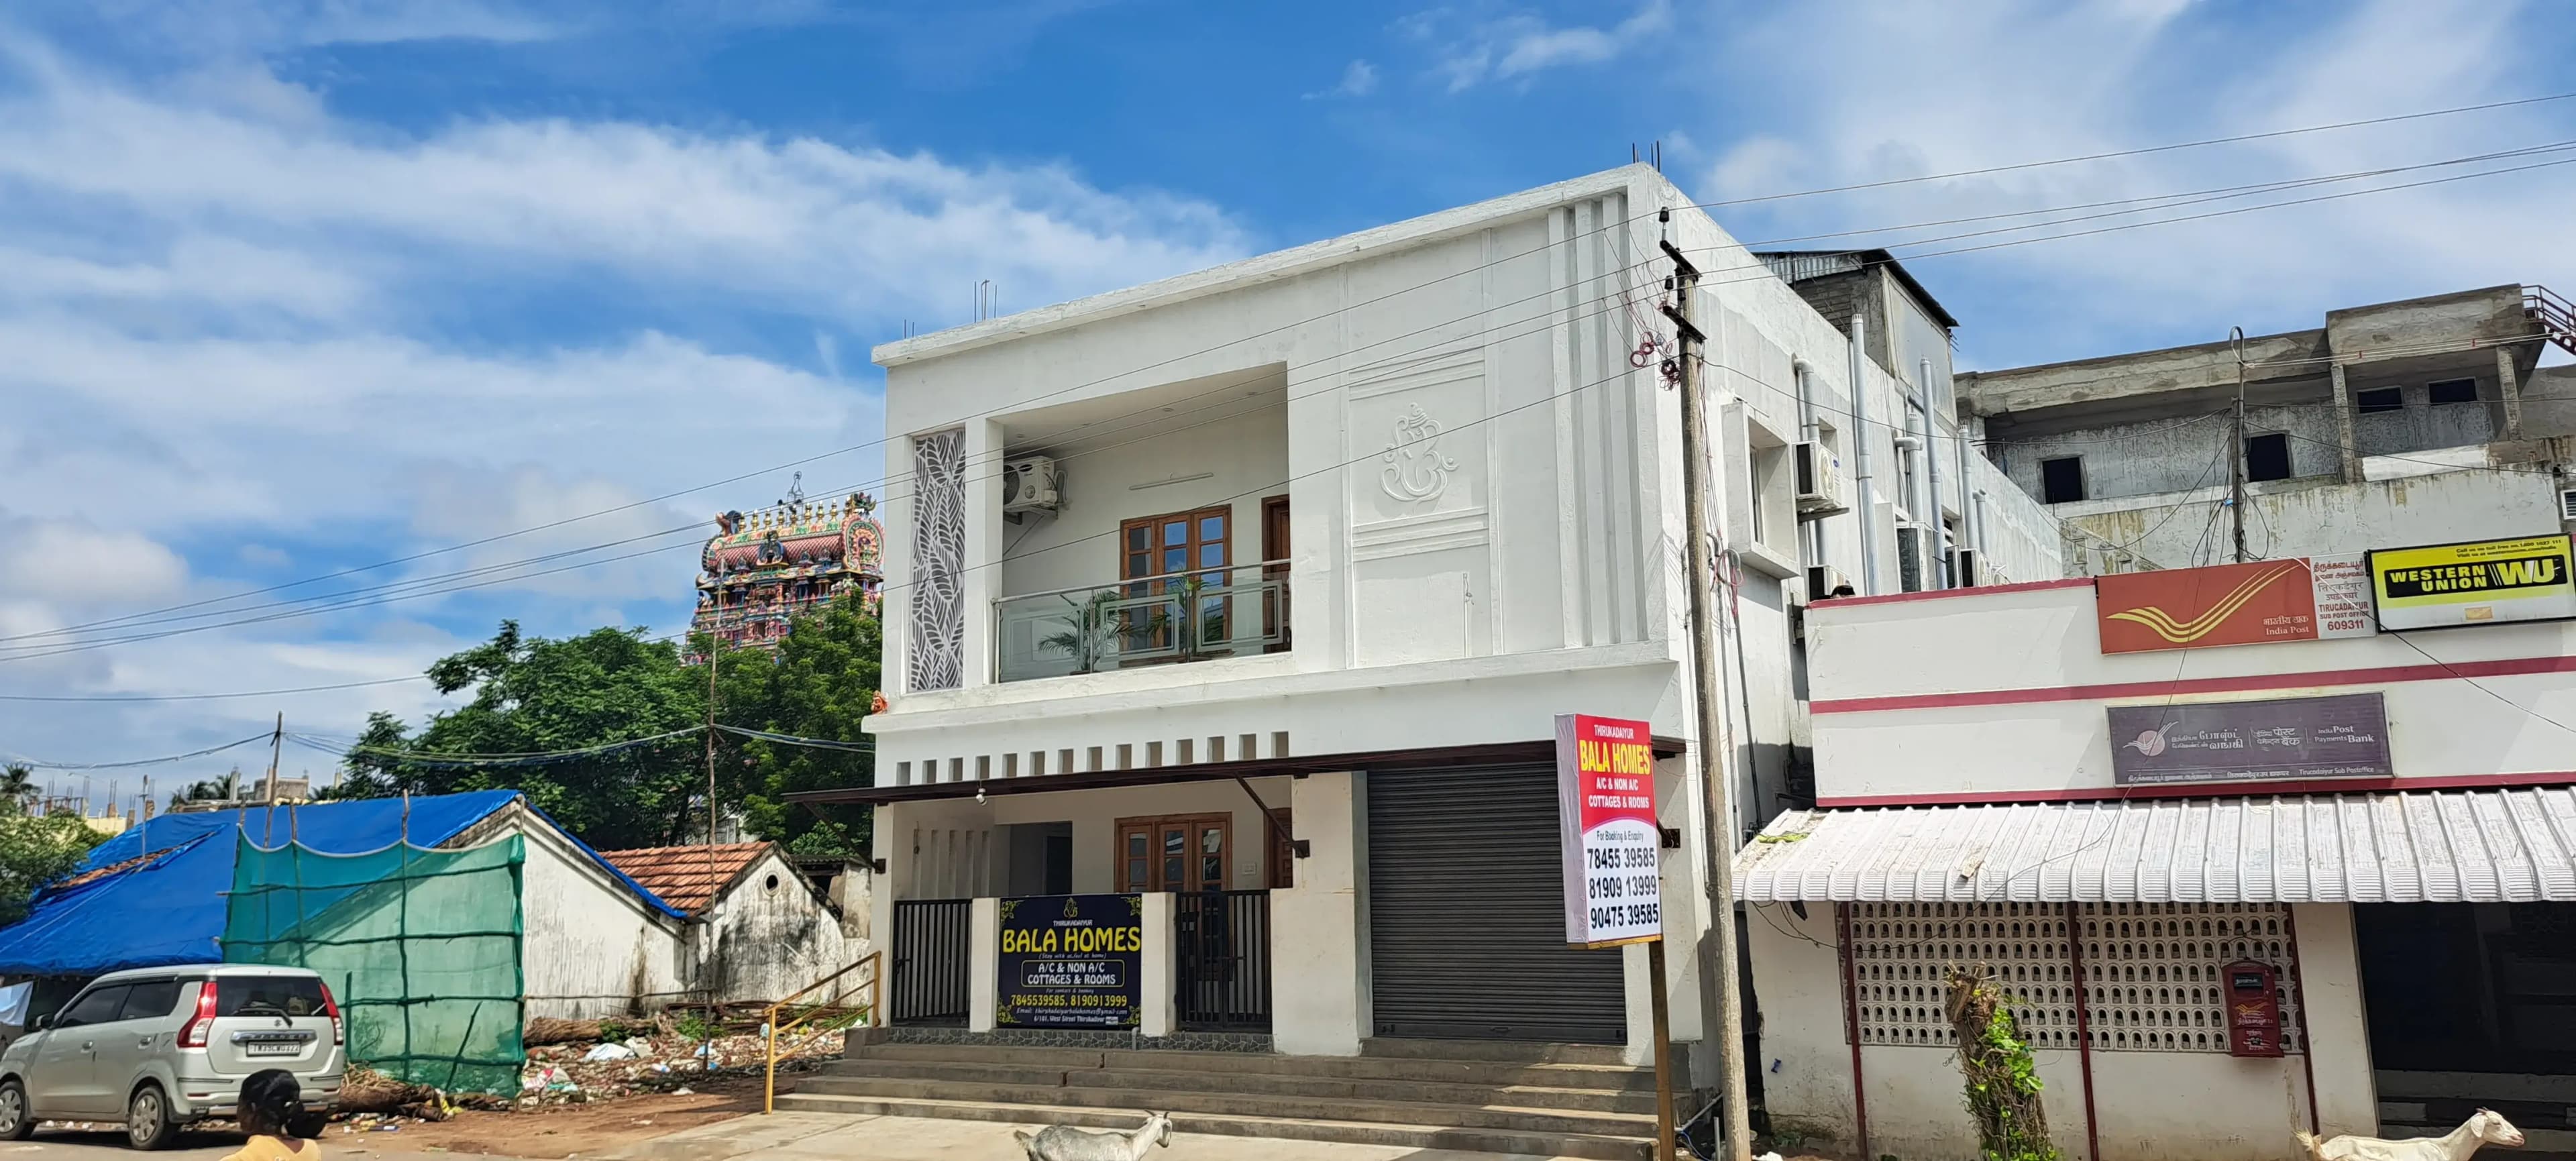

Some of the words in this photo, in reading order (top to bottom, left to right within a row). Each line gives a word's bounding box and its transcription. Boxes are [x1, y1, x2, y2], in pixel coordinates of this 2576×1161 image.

[2390, 565, 2485, 583] WESTERN
[2496, 558, 2555, 586] WU
[2421, 577, 2487, 592] UNION
[2263, 615, 2291, 625] भारतीय
[2327, 619, 2364, 630] 609311
[2265, 627, 2288, 635] India
[2290, 626, 2309, 634] Post
[1594, 724, 1634, 739] THIRUKADAIYUR
[2199, 728, 2241, 741] போஸ்ட்
[2272, 726, 2296, 736] पोस्ट
[2332, 725, 2354, 734] Post
[2314, 735, 2347, 743] Payments
[2347, 734, 2375, 743] Bank
[1579, 739, 1610, 773] BALA
[1613, 742, 1650, 775] HOMES
[1596, 777, 1607, 790] A/C
[1608, 778, 1613, 790] &
[1614, 777, 1627, 791] NON
[1629, 778, 1638, 791] A/C
[1589, 795, 1621, 808] COTTAGES
[1622, 795, 1627, 809] &
[1628, 796, 1650, 809] ROOMS
[1605, 831, 1623, 843] Booking
[1623, 832, 1627, 841] &
[1627, 830, 1644, 843] Enquiry
[1587, 848, 1621, 869] 78455
[1624, 848, 1655, 869] 39585
[1589, 877, 1622, 899] 81909
[1626, 875, 1657, 897] 13999
[1591, 906, 1624, 930] 90475
[1627, 903, 1658, 925] 39585
[1003, 928, 1057, 952] BALA
[1065, 926, 1141, 952] HOMES
[1038, 962, 1055, 973] A/C
[1057, 963, 1065, 973] &
[1067, 962, 1086, 973] NON
[1088, 962, 1106, 973] A/C
[1027, 975, 1071, 985] COTTAGES
[1073, 975, 1081, 985] &
[1084, 974, 1116, 985] ROOMS
[1070, 995, 1128, 1007] 8190913999
